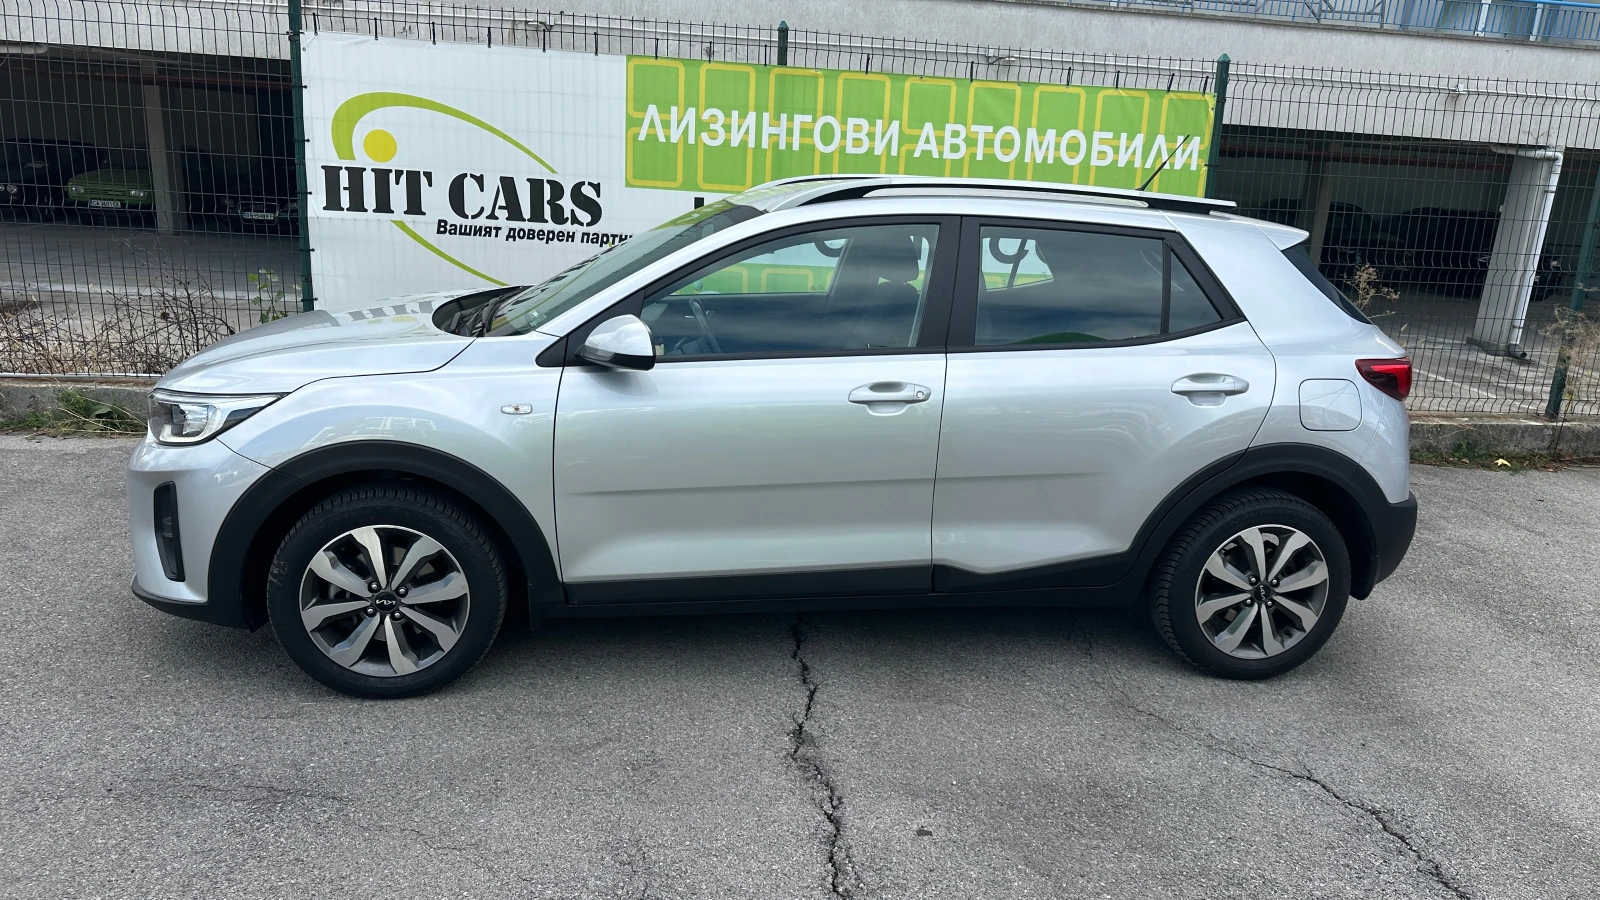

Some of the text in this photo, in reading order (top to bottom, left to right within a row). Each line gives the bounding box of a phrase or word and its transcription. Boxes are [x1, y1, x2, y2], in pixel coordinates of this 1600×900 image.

[637, 104, 1201, 171] ЛИЗИНГОВИ АВТОМОБИЛИ
[321, 165, 603, 227] HIT CARS
[436, 219, 633, 248] Вашият доверен партн
